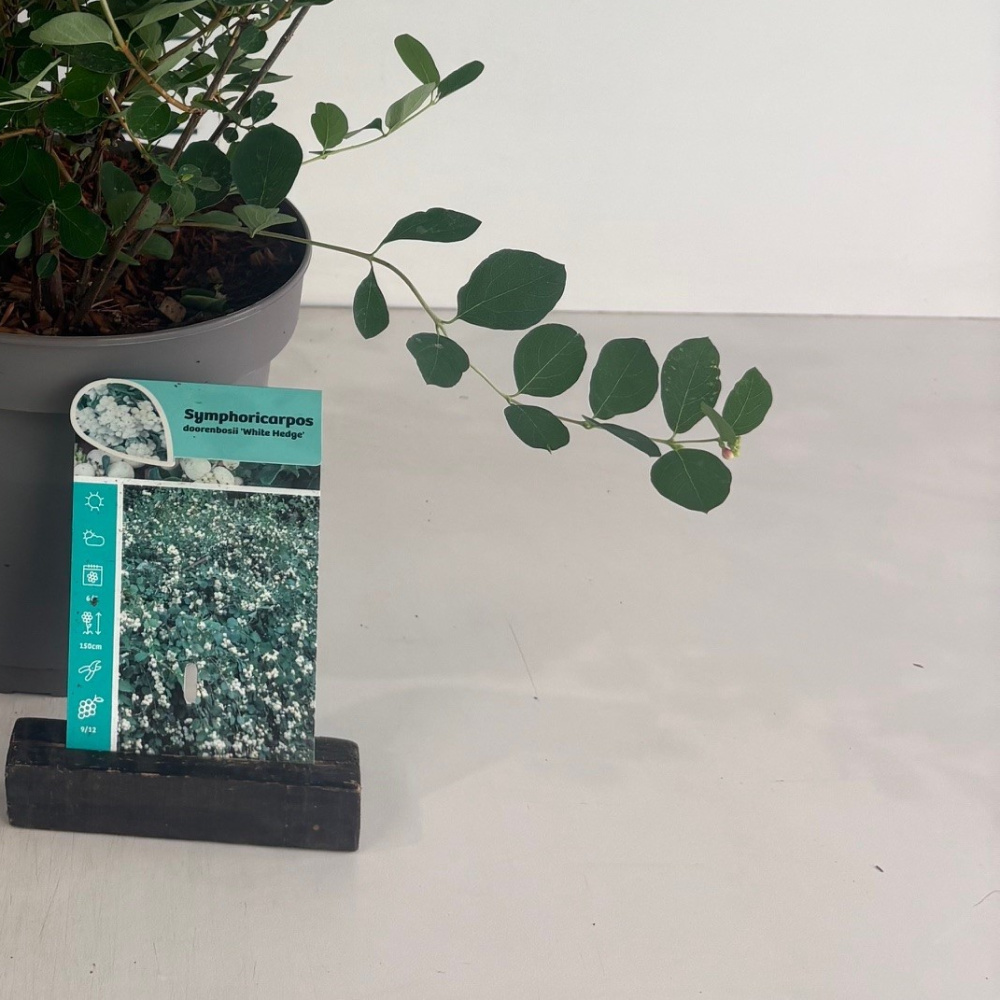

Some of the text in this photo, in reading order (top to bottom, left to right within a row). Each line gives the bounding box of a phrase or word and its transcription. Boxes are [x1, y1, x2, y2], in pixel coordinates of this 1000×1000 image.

[184, 408, 314, 428] Symphoricarpos
[183, 424, 305, 440] doorenbosii 'White Hedge'
[79, 642, 103, 650] 150cm
[80, 725, 97, 733] 9/12
